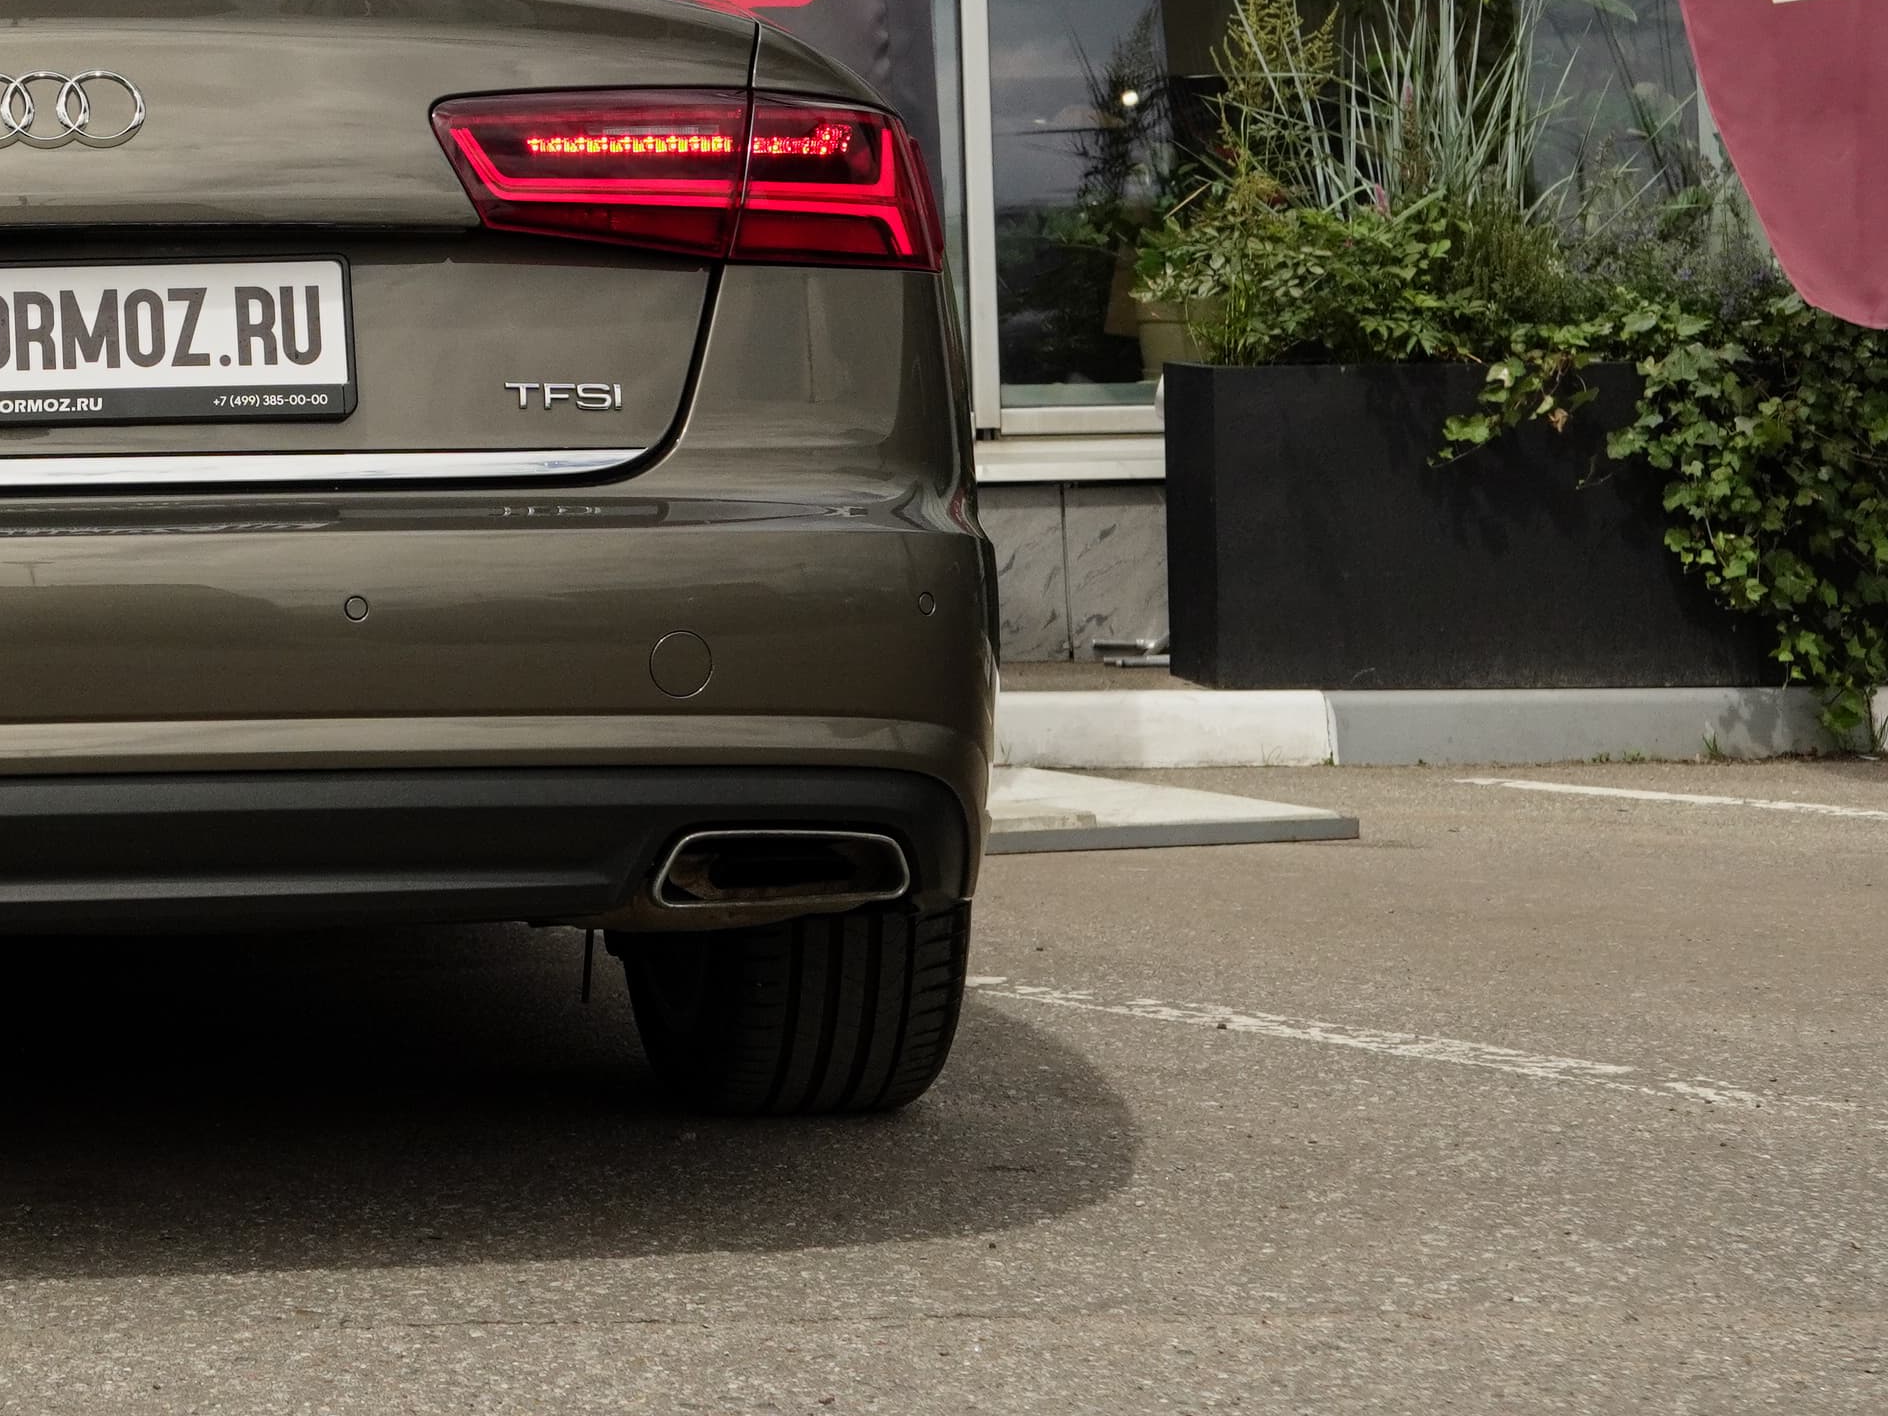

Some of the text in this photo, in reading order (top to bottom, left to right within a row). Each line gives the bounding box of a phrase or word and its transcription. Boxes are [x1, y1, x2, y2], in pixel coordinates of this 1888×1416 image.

[213, 393, 329, 409] +7 (499) 385-00-00
[504, 382, 623, 410] TFSI
